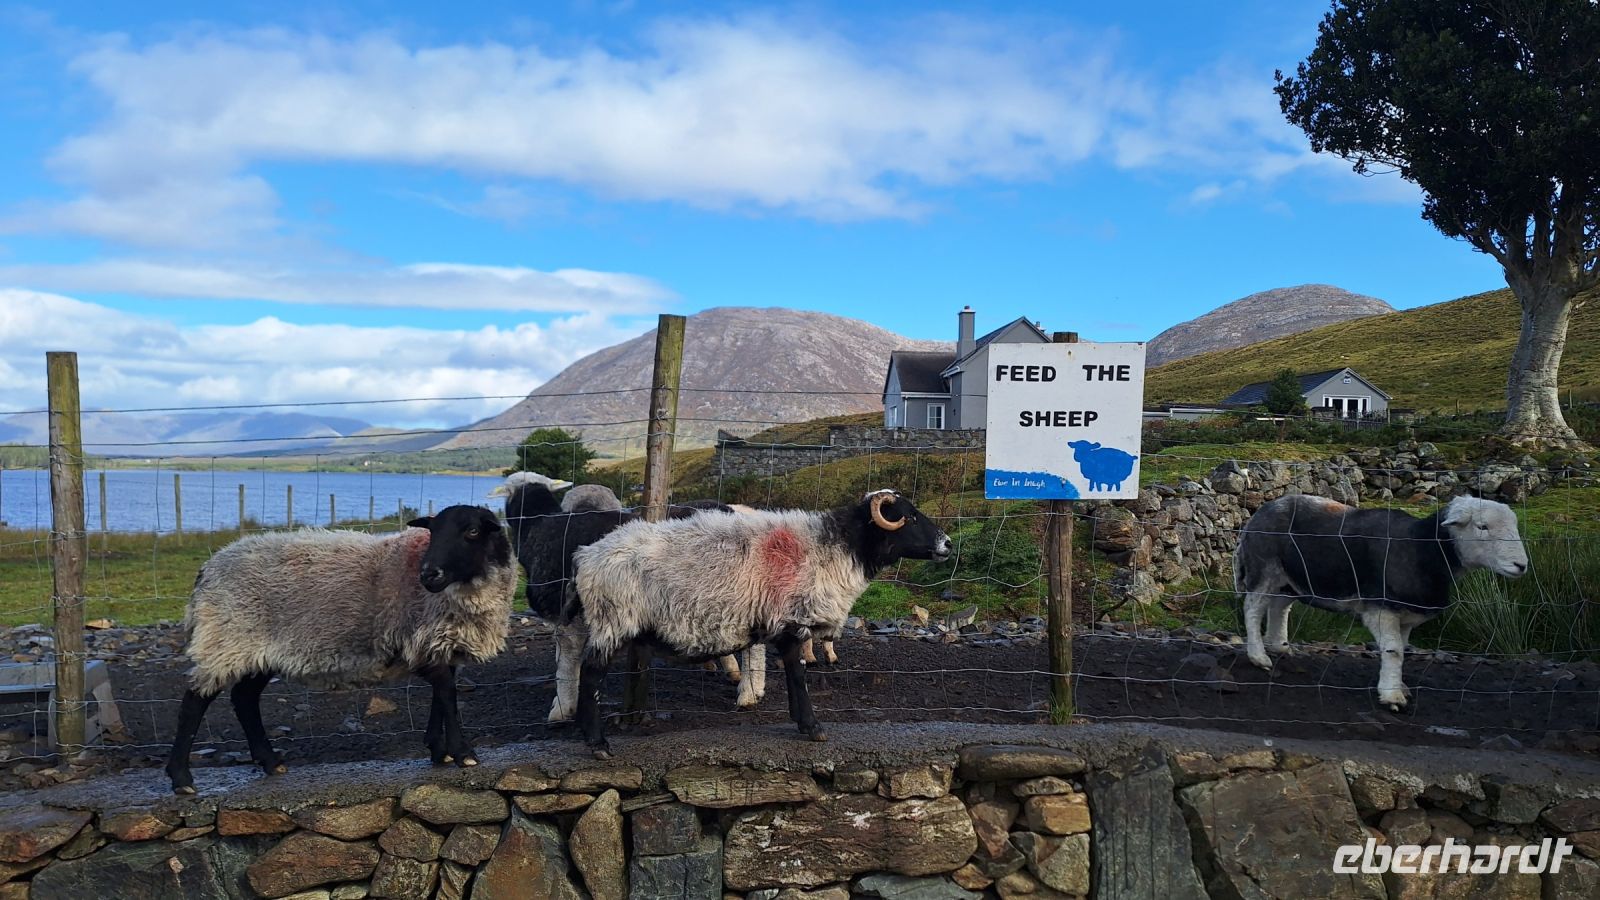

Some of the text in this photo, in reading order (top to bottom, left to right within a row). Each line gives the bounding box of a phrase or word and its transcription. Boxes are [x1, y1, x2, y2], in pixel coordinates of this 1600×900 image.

[995, 364, 1131, 382] FEED THE
[1019, 410, 1099, 427] SHEEP
